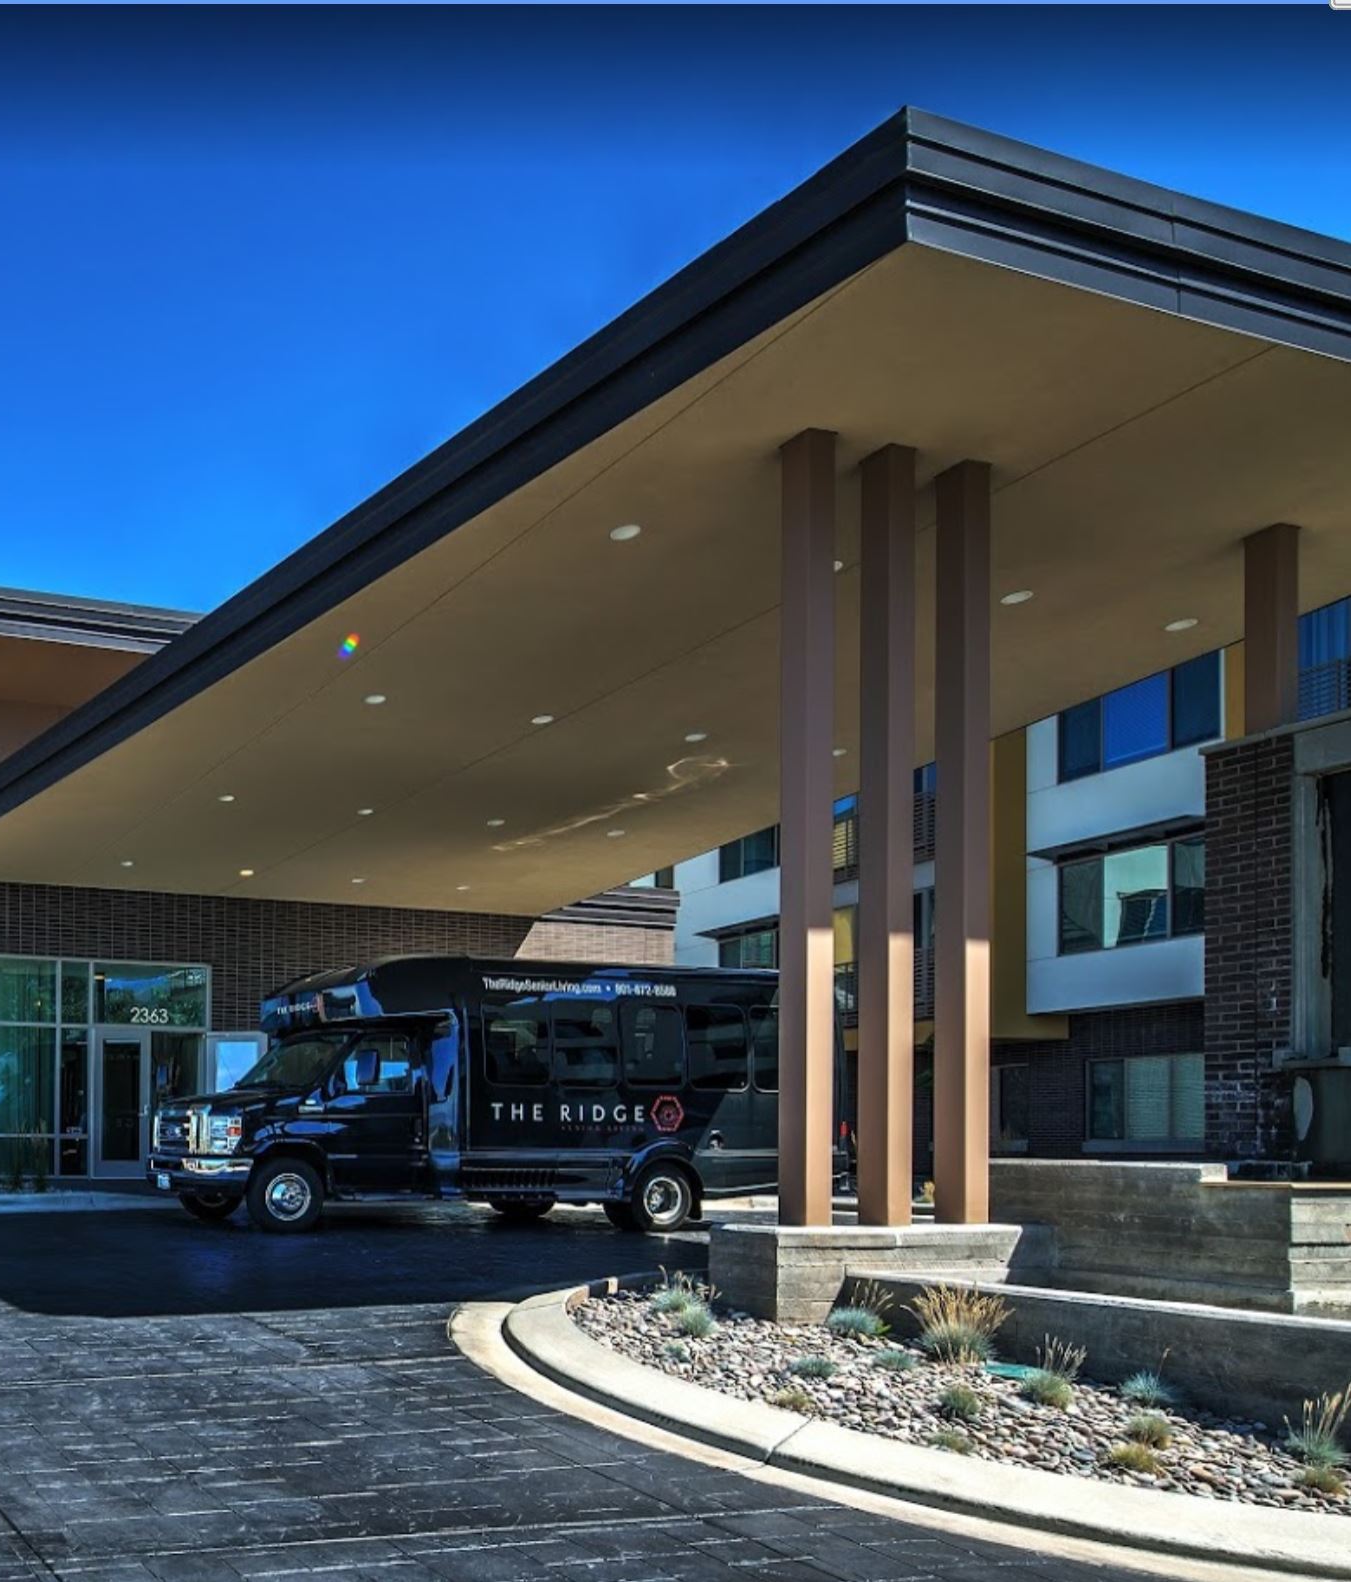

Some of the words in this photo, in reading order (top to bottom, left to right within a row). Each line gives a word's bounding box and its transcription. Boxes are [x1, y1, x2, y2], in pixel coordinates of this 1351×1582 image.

[130, 1007, 170, 1024] 2363
[491, 1103, 544, 1122] THE
[560, 1104, 645, 1123] RIDGE
